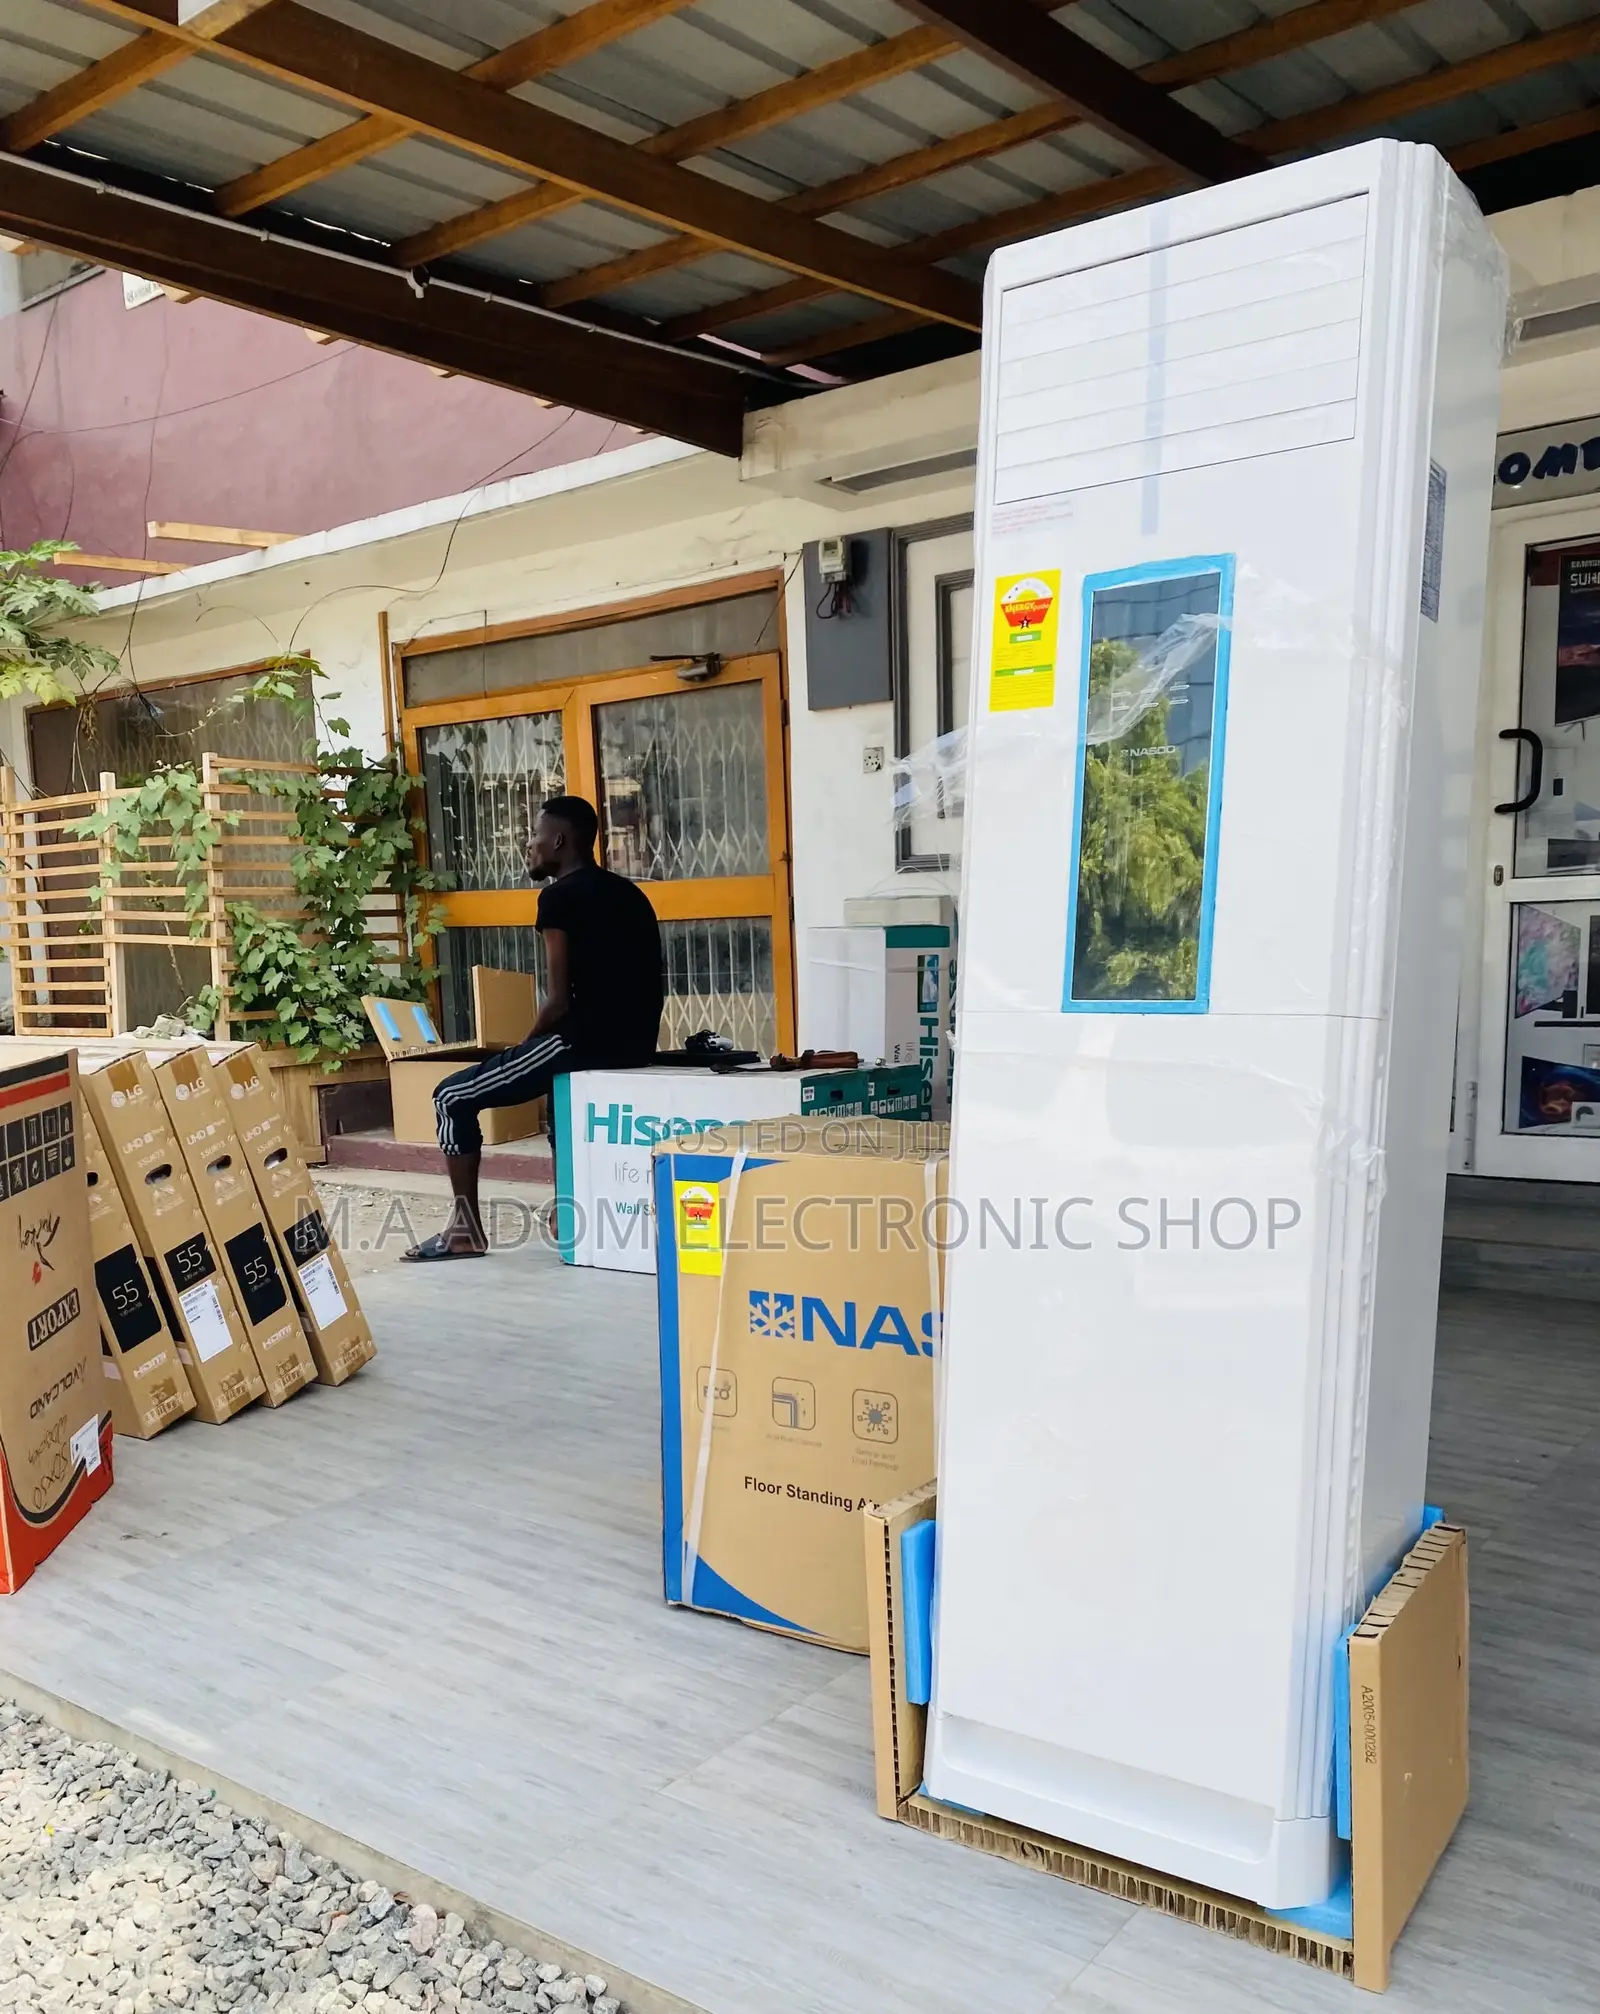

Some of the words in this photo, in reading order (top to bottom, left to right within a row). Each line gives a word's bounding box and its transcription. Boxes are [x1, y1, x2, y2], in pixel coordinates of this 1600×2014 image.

[1129, 745, 1176, 757] NASCO
[893, 1044, 901, 1063] Wal
[126, 1083, 143, 1100] LG
[189, 1077, 205, 1093] LG
[244, 1075, 260, 1091] LG
[243, 1126, 261, 1142] UHD
[587, 1102, 754, 1147] Hise
[187, 1130, 206, 1145] UHD
[614, 1161, 640, 1184] life
[615, 1202, 640, 1216] Wall
[294, 1222, 318, 1249] 55
[176, 1244, 203, 1273] 55
[243, 1256, 268, 1285] 55
[112, 1279, 140, 1310] 55
[31, 1292, 78, 1348] EXPORT
[802, 1296, 944, 1357] NAS
[744, 1476, 782, 1495] Floor
[786, 1484, 853, 1513] Standing
[1361, 1685, 1378, 1764] A2005-000282
